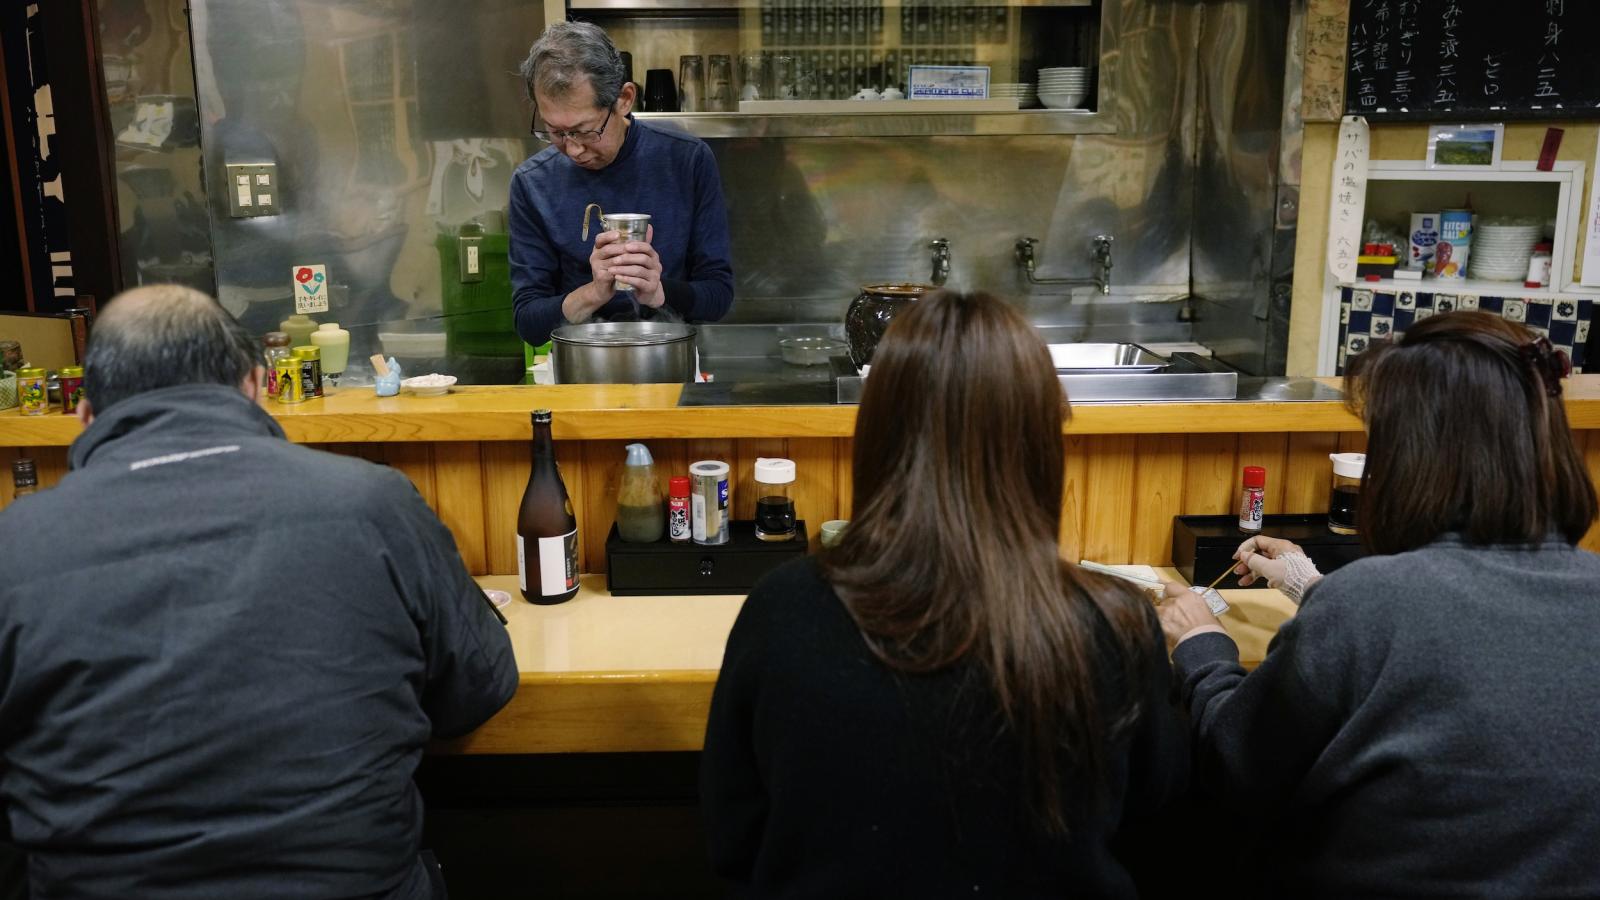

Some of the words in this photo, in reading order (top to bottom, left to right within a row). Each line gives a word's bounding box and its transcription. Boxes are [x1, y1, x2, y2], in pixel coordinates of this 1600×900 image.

[1338, 132, 1363, 222] サバの塩焼き
